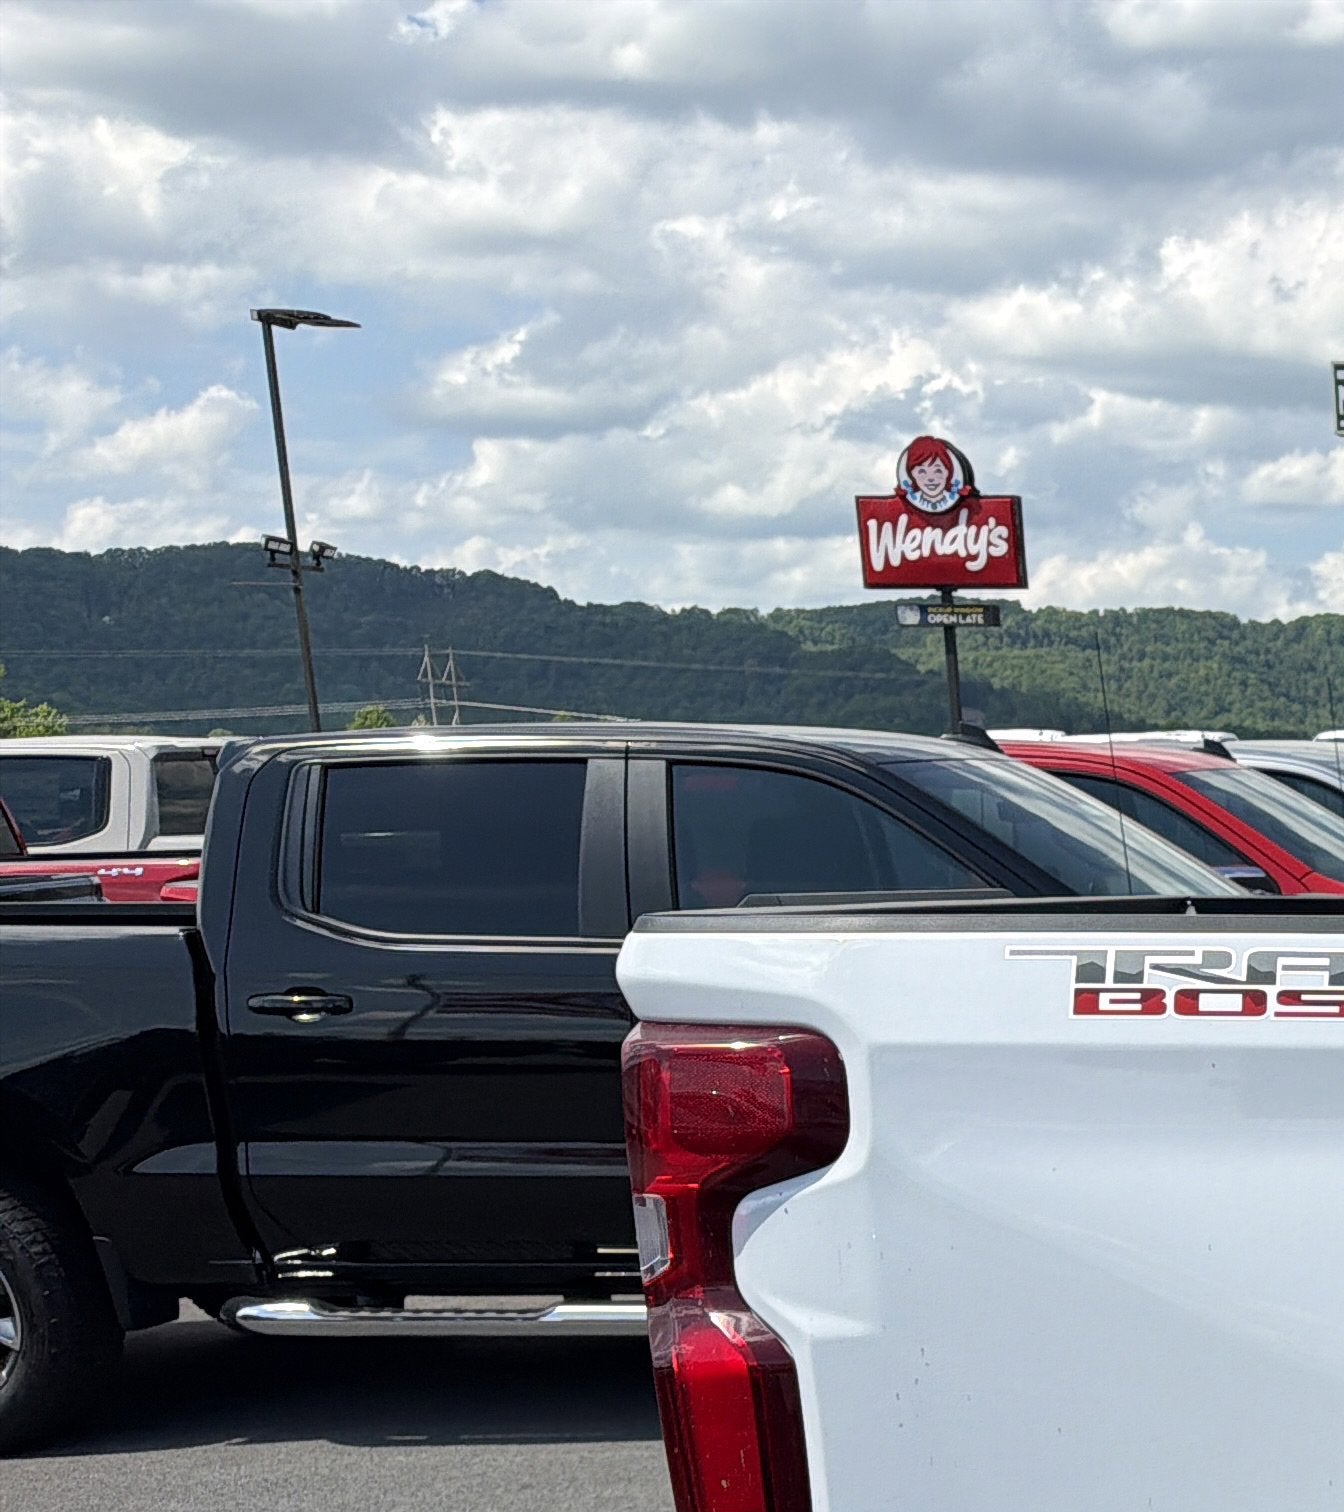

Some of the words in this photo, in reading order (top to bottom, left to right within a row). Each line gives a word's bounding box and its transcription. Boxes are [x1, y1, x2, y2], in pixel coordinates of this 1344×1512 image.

[867, 508, 1009, 572] Wendy's
[928, 613, 957, 625] OPEN
[958, 613, 985, 625] LATE
